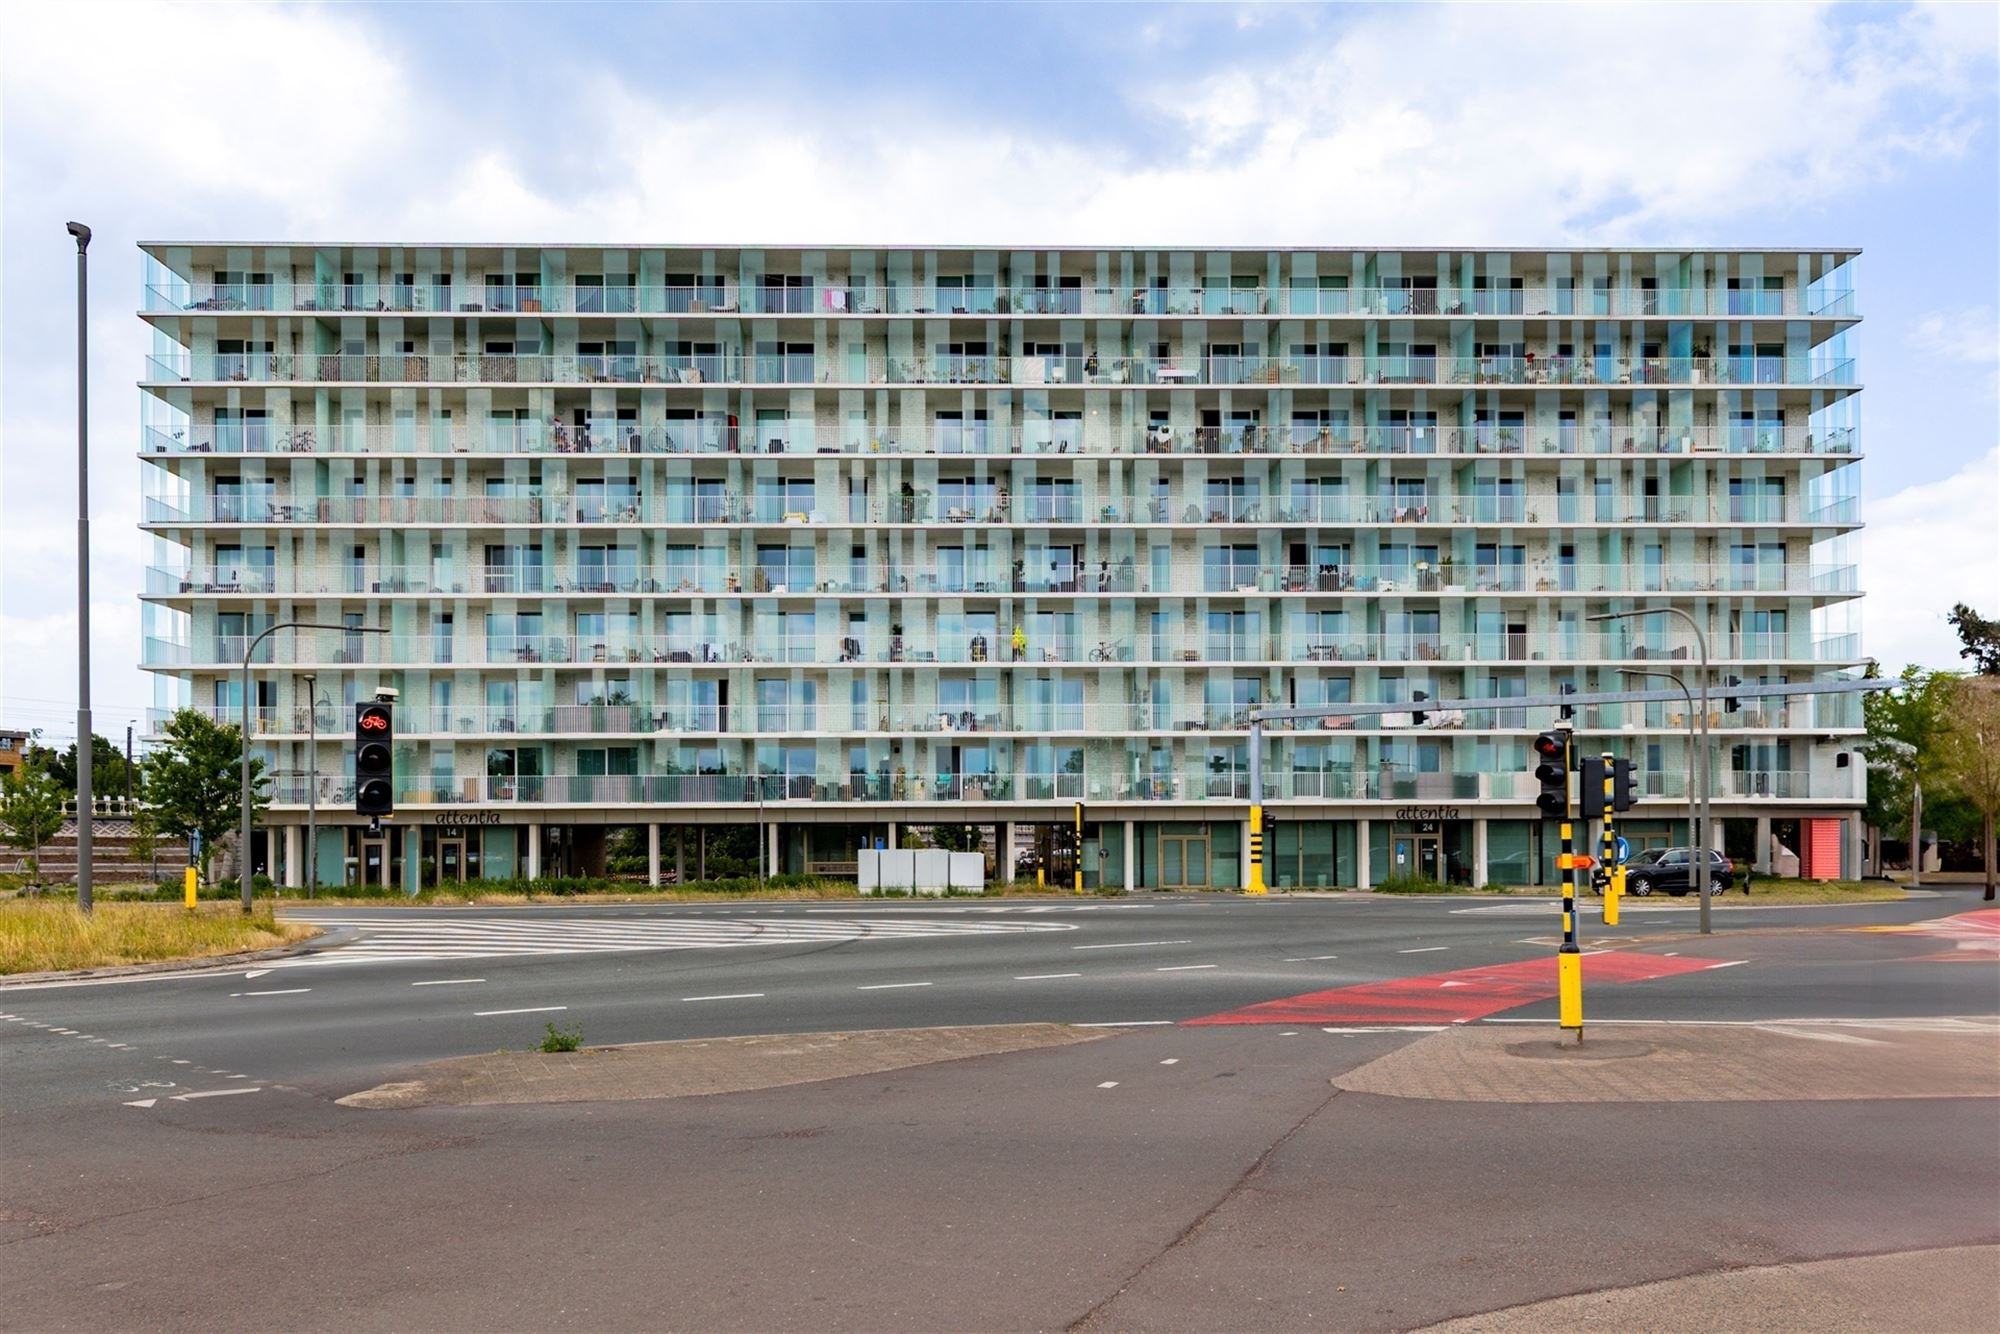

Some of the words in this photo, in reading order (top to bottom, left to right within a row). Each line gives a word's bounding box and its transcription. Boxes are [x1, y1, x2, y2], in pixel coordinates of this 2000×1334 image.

[435, 809, 501, 825] attentia
[1396, 805, 1460, 820] attentia
[446, 828, 456, 837] 14
[1422, 823, 1433, 832] 24
